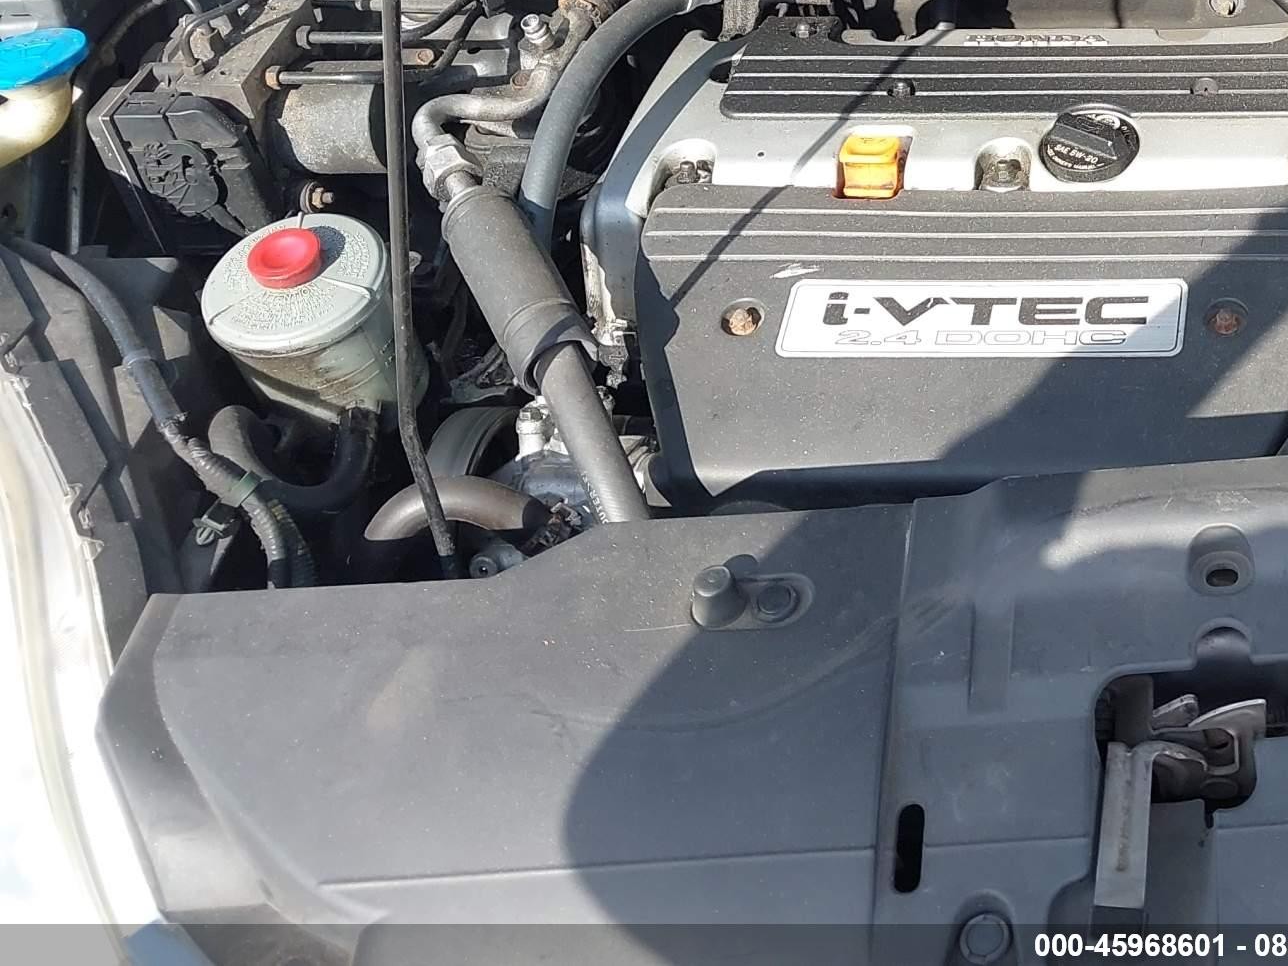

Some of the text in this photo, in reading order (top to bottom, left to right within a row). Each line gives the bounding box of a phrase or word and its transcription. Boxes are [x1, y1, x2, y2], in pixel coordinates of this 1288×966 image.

[1054, 144, 1099, 164] SAE 5W-20
[822, 291, 1149, 326] i-VTEC
[835, 329, 1127, 346] 2.4 DOHC
